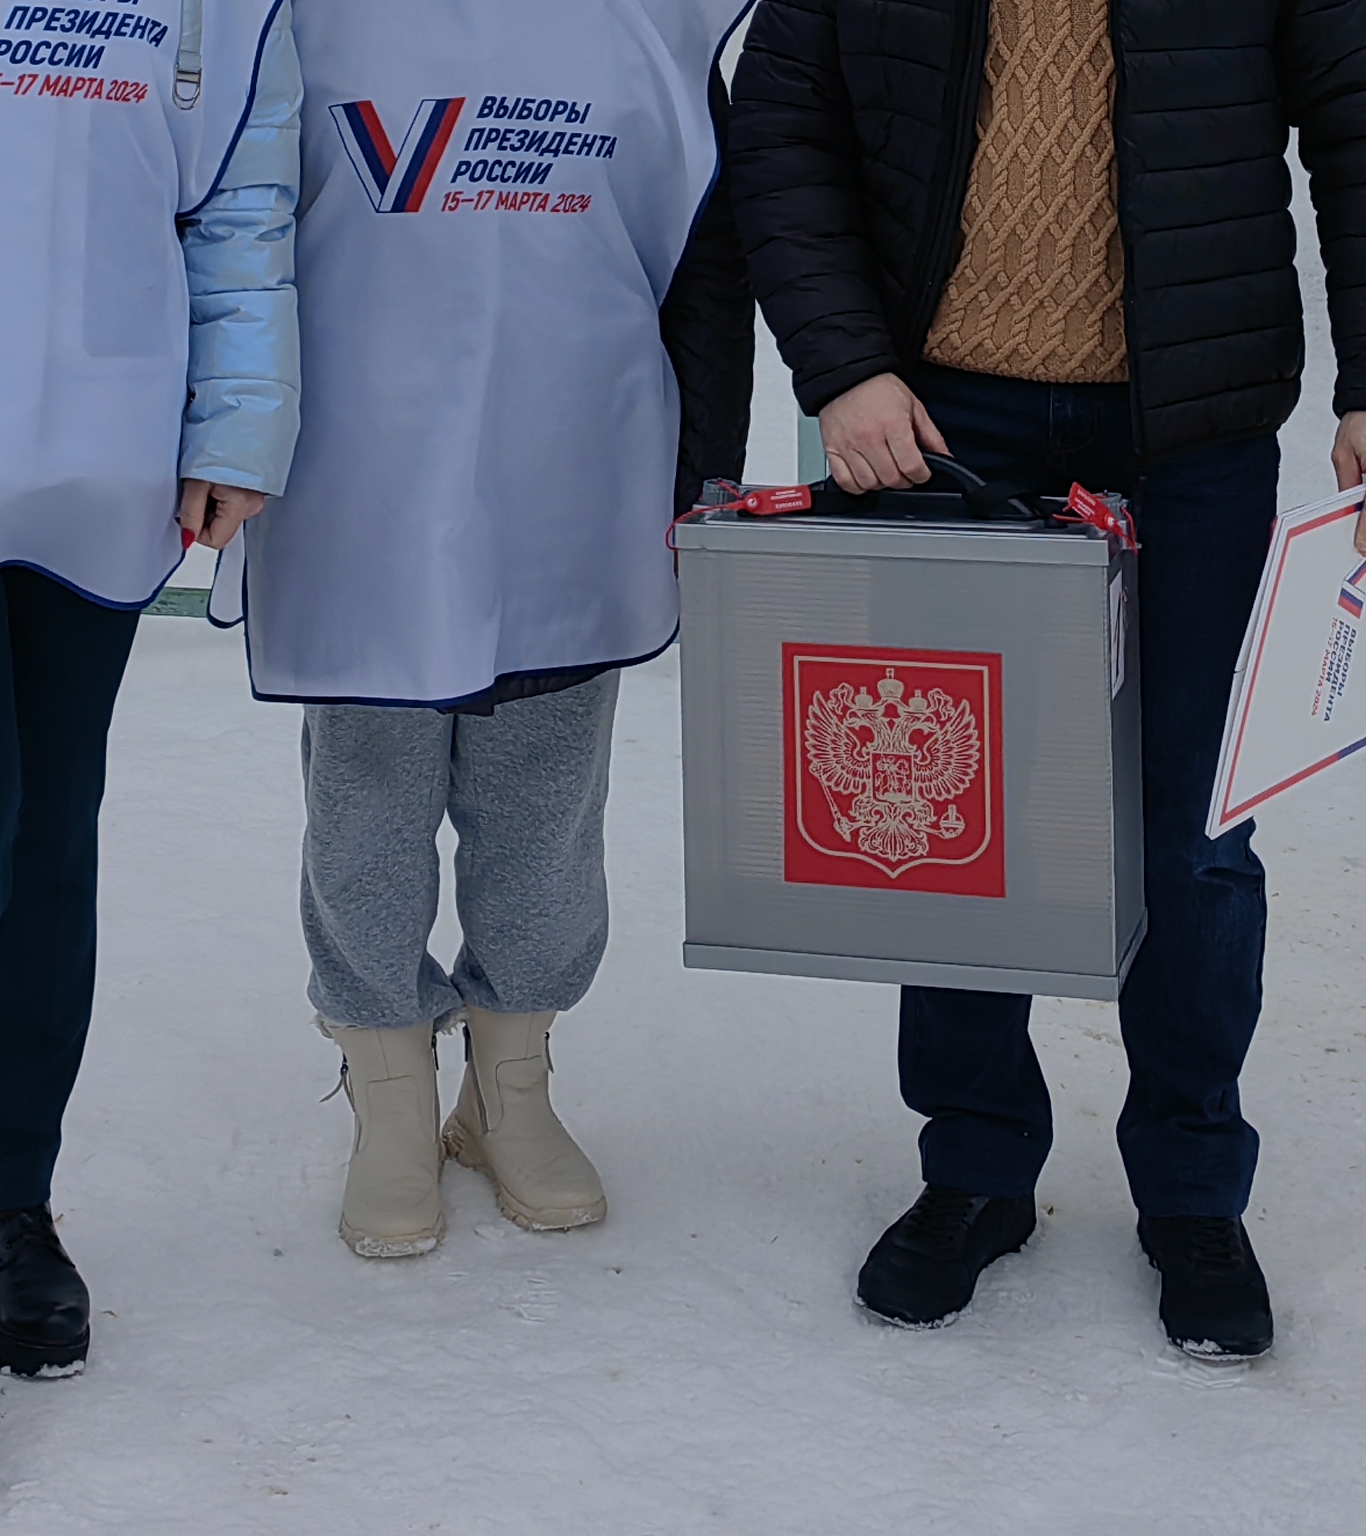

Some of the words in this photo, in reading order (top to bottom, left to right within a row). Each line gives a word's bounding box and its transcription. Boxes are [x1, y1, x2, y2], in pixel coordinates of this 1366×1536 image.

[4, 6, 169, 48] ПРЕЗИДЕНТА
[38, 74, 104, 99] МАРТА
[105, 79, 149, 103] 2024
[476, 96, 592, 125] ВЫБОРЫ
[464, 127, 618, 159] ПРЕЗИДЕНТА
[450, 160, 553, 185] РОССИИ
[495, 190, 550, 213] МАРТА
[550, 194, 593, 214] 2024
[1317, 649, 1331, 687] МАРТА
[1325, 620, 1344, 683] РОССИИ
[1337, 628, 1357, 697] ВЫБОРЫ
[1324, 624, 1351, 722] ПРЕЗИДЕНТА
